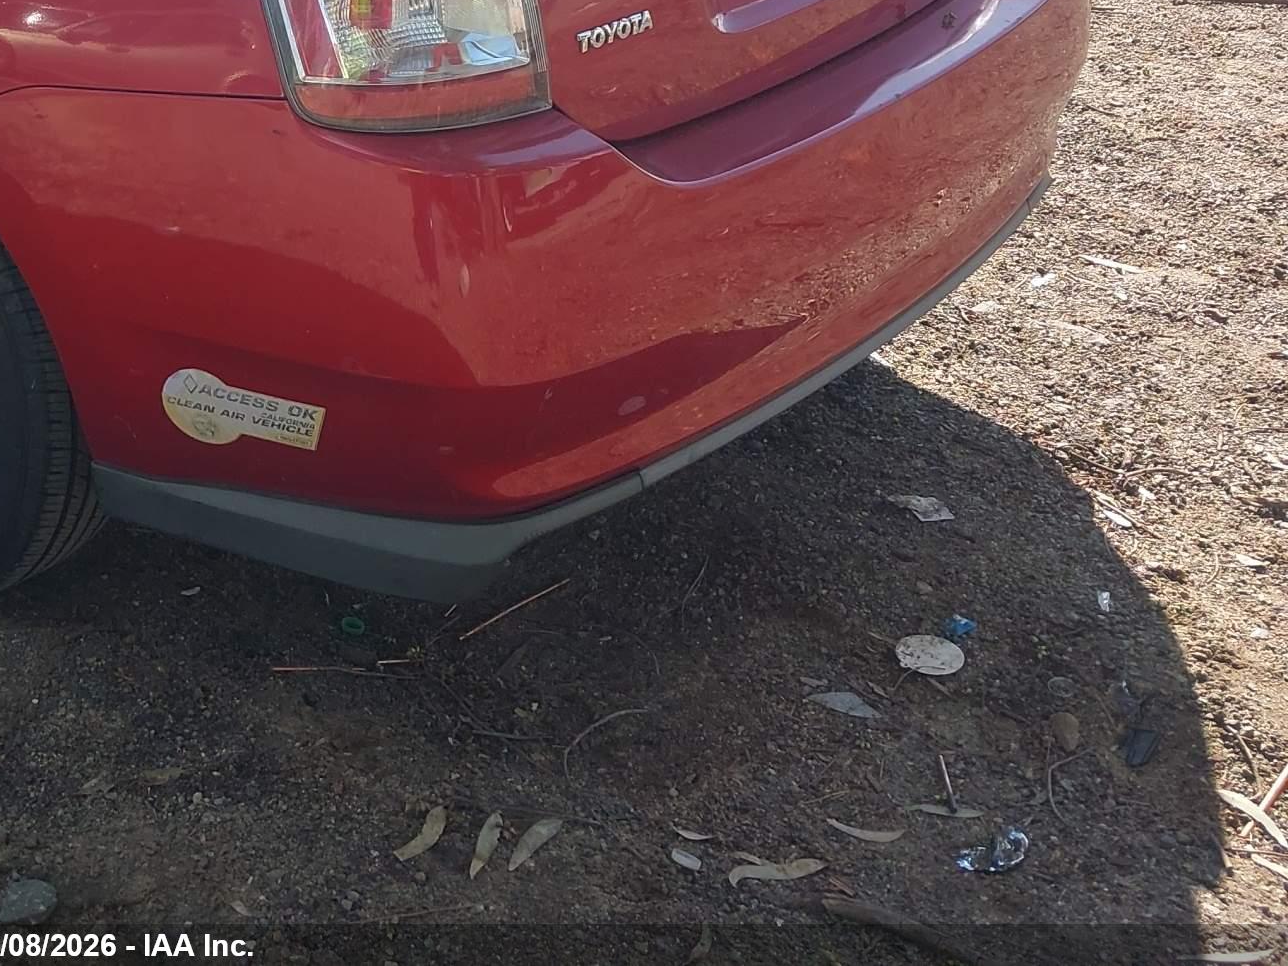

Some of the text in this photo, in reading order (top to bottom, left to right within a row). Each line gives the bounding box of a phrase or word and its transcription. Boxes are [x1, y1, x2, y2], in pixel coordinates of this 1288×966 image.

[576, 9, 653, 54] TOYOTA
[167, 396, 314, 437] CLEAN AIR VEHICLE
[198, 384, 318, 421] ACCESS OK
[261, 413, 315, 430] CALIFORNIA
